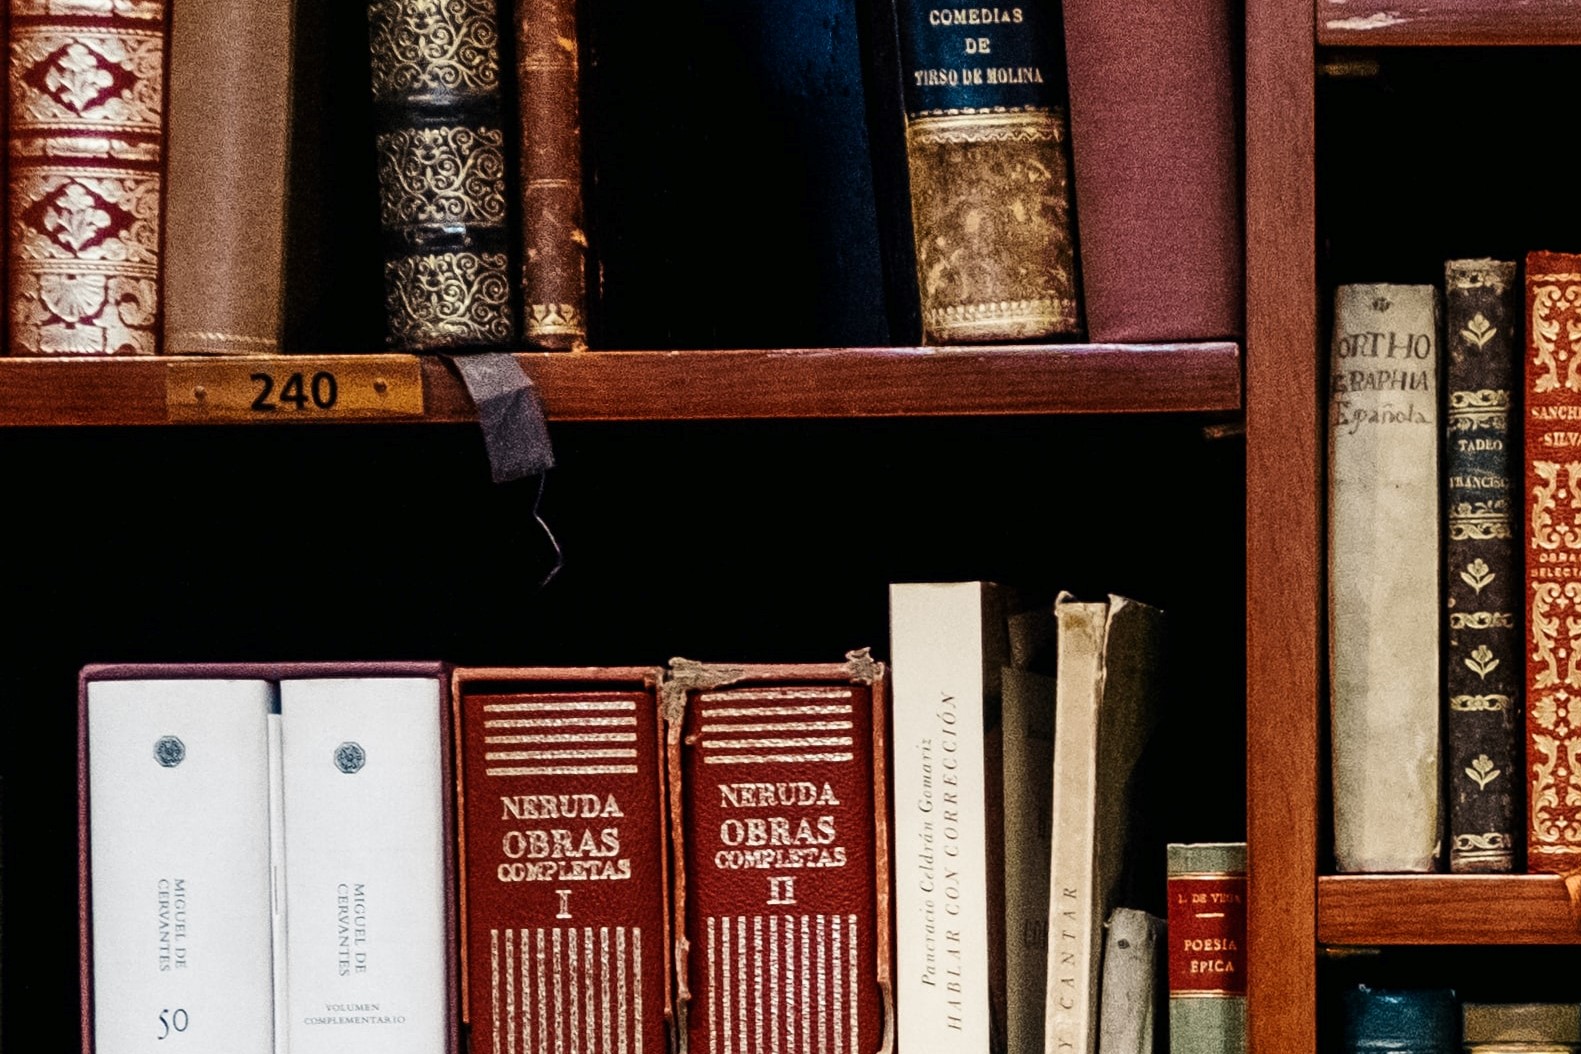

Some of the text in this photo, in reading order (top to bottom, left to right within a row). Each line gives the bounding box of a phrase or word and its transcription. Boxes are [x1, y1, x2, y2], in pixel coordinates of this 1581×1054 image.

[929, 8, 1024, 26] COMEDIAS
[965, 37, 991, 54] DE
[914, 67, 1044, 87] TIRSO DE MOLINA
[248, 371, 338, 412] 240
[500, 793, 625, 821] NERUDA
[718, 781, 840, 809] NERUDA
[502, 827, 621, 860] OBRAS
[719, 815, 836, 848] OBRAS
[497, 859, 632, 882] COMPLETAS
[713, 846, 848, 871] COMPLETAS
[940, 692, 963, 1032] HABLAR CON CORRECCIÓN
[555, 889, 573, 919] I
[158, 878, 171, 973] CERVANTES
[174, 878, 188, 970] MIGUEL DE
[337, 883, 351, 977] CERVANTES
[353, 883, 367, 975] MIGUEL DE
[1060, 885, 1079, 1011] CANTAR
